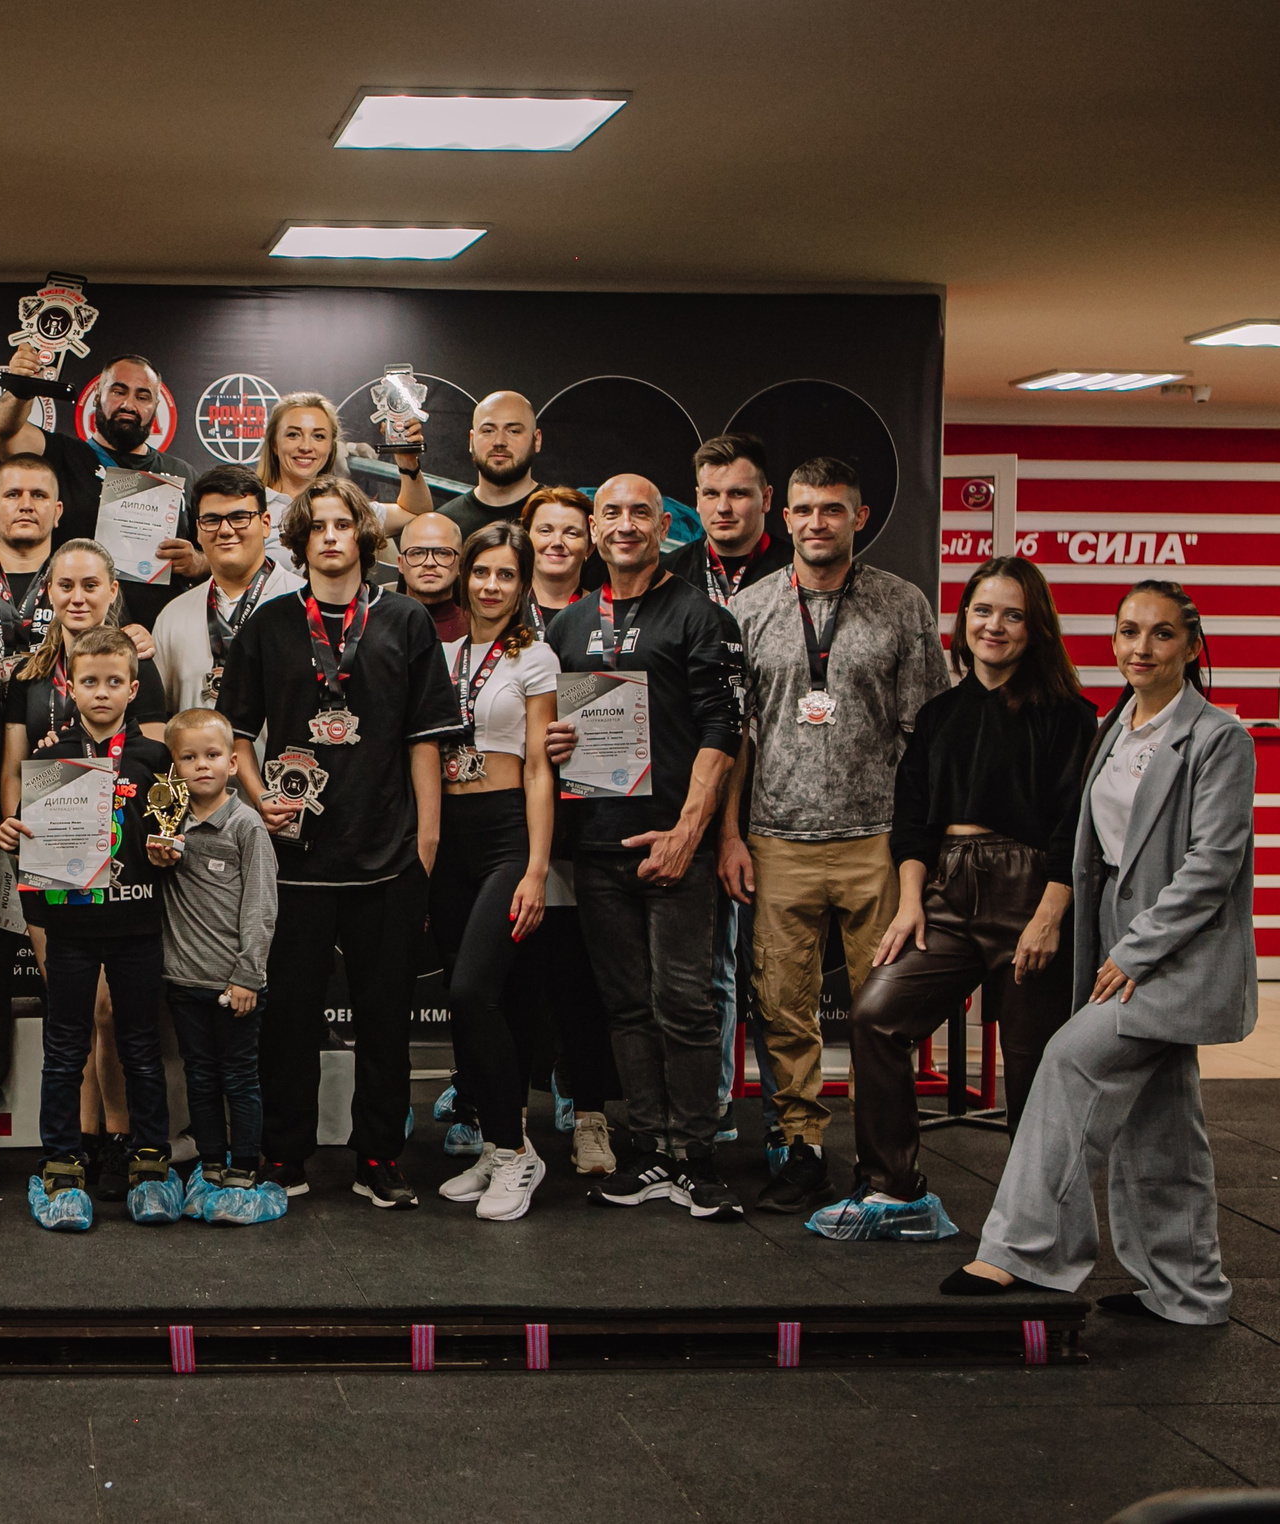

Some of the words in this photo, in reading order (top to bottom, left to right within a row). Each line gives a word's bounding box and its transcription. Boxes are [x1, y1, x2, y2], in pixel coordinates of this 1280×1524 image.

[208, 405, 266, 426] POWER
[120, 500, 159, 513] ДИПЛОМ
[1056, 531, 1198, 565] "СИЛА"
[581, 707, 625, 718] ДИПЛОМ
[24, 760, 64, 789] ЖИМОВОЙ
[33, 772, 62, 791] ТУРНИР
[44, 796, 89, 807] ДИПЛОМ
[1, 871, 13, 910] ДИПЛОМ
[108, 884, 153, 901] LEON
[421, 1008, 451, 1022] КМ
